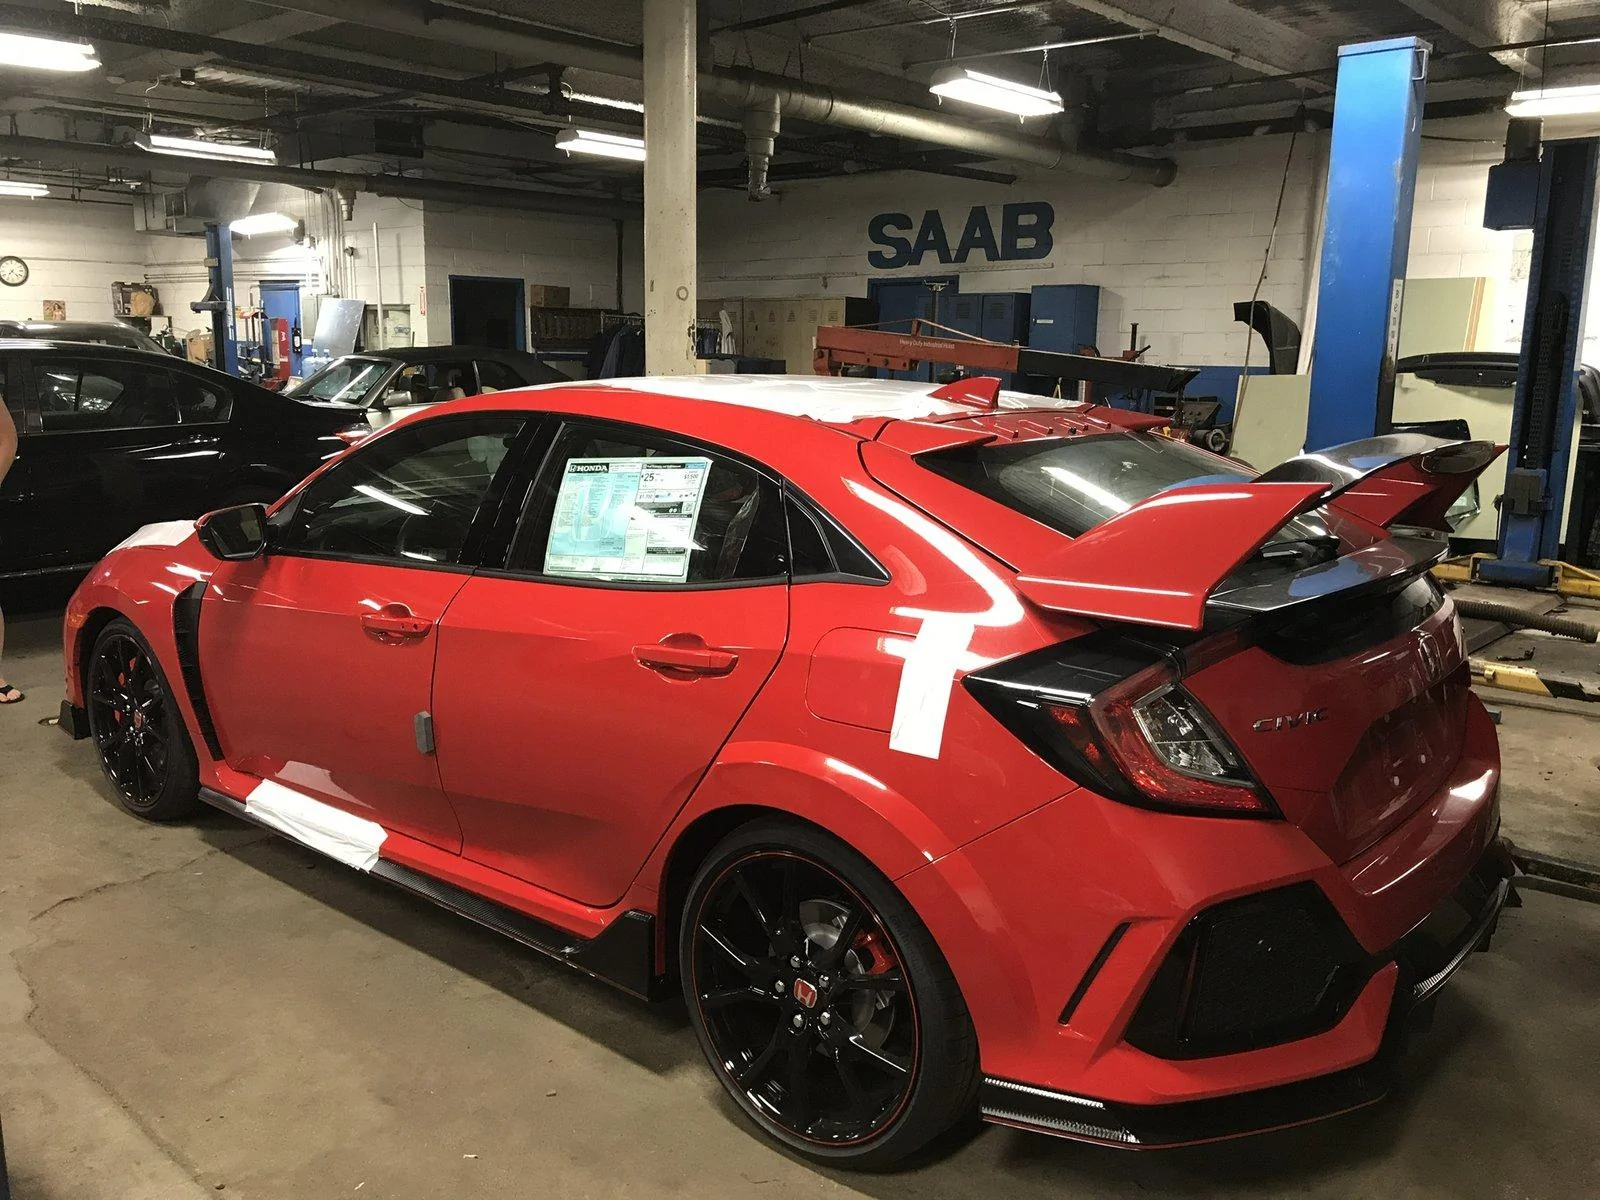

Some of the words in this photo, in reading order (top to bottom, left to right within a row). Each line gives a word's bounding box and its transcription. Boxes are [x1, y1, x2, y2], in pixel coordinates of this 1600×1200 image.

[868, 202, 1055, 269] SAAB
[576, 465, 608, 473] HONDA
[643, 472, 655, 482] 25
[1252, 707, 1328, 732] CIVIC
